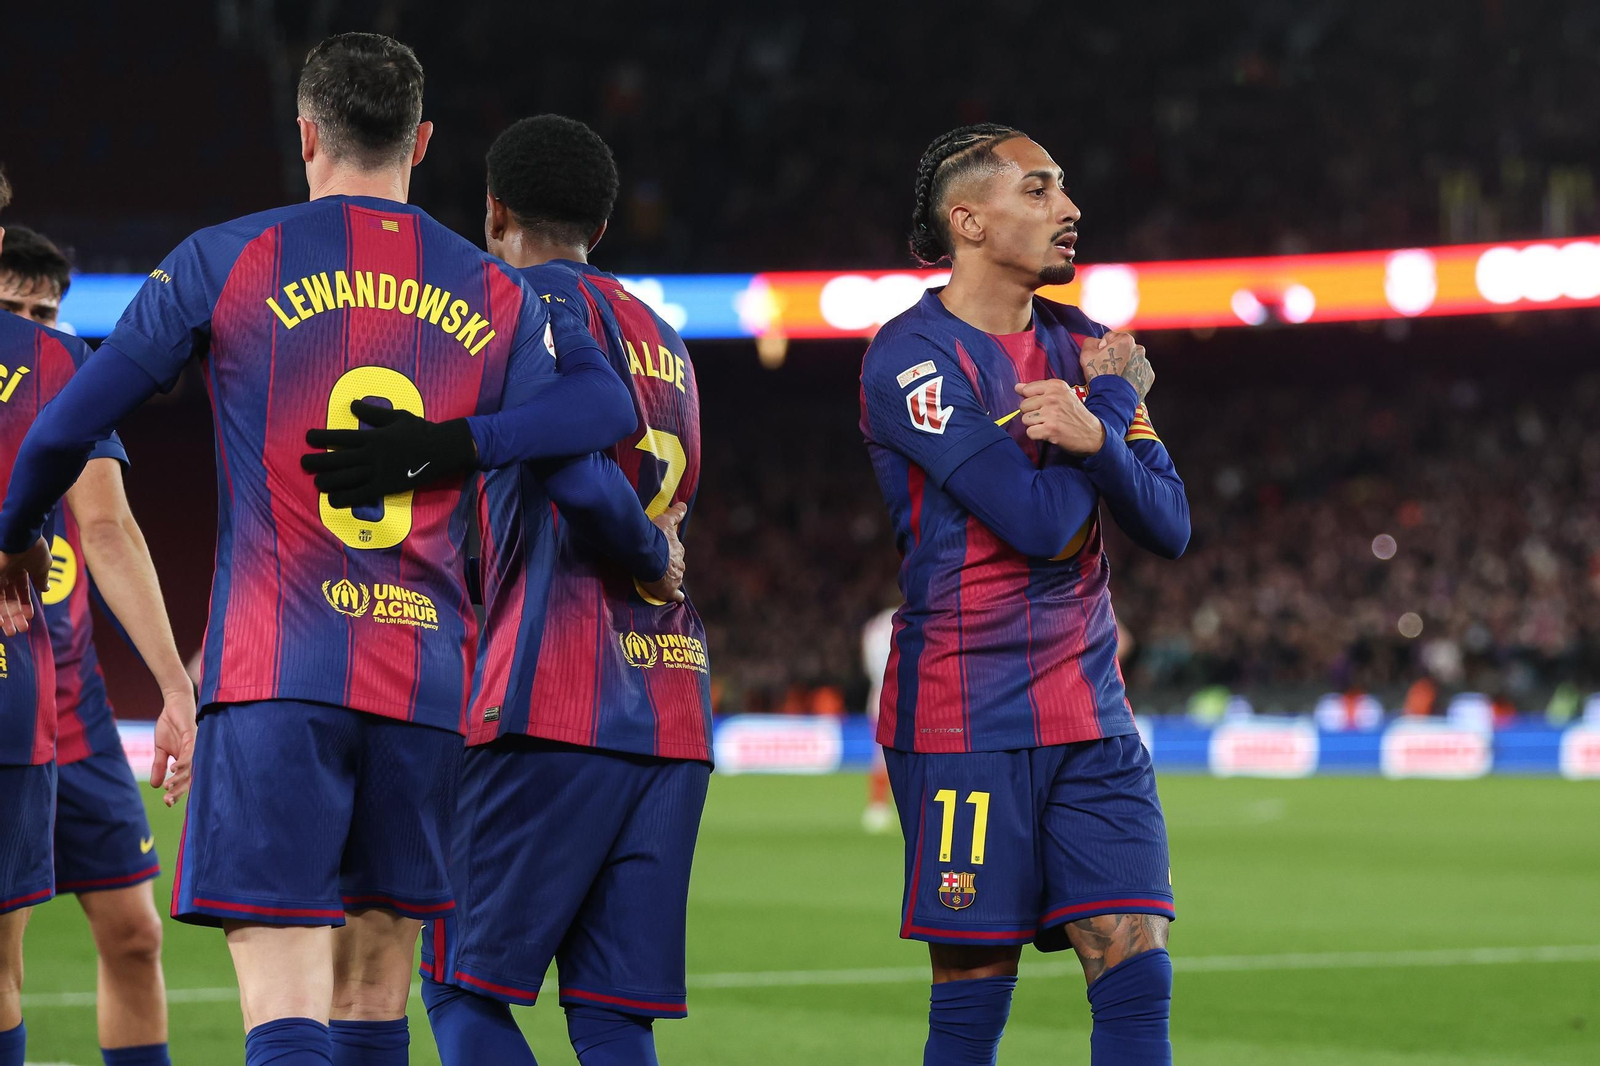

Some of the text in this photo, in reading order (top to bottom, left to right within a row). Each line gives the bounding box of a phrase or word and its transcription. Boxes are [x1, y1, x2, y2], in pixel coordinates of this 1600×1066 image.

[265, 270, 496, 357] LEWANDOWSKI
[617, 336, 686, 394] ALDE
[373, 583, 436, 608] UNHCR
[372, 600, 439, 623] ACNUR
[373, 616, 385, 624] The
[397, 618, 420, 627] Refugee
[421, 621, 439, 631] Agency
[655, 634, 704, 653] UNHCR
[662, 648, 707, 668] ACNUR
[933, 788, 991, 865] 11
